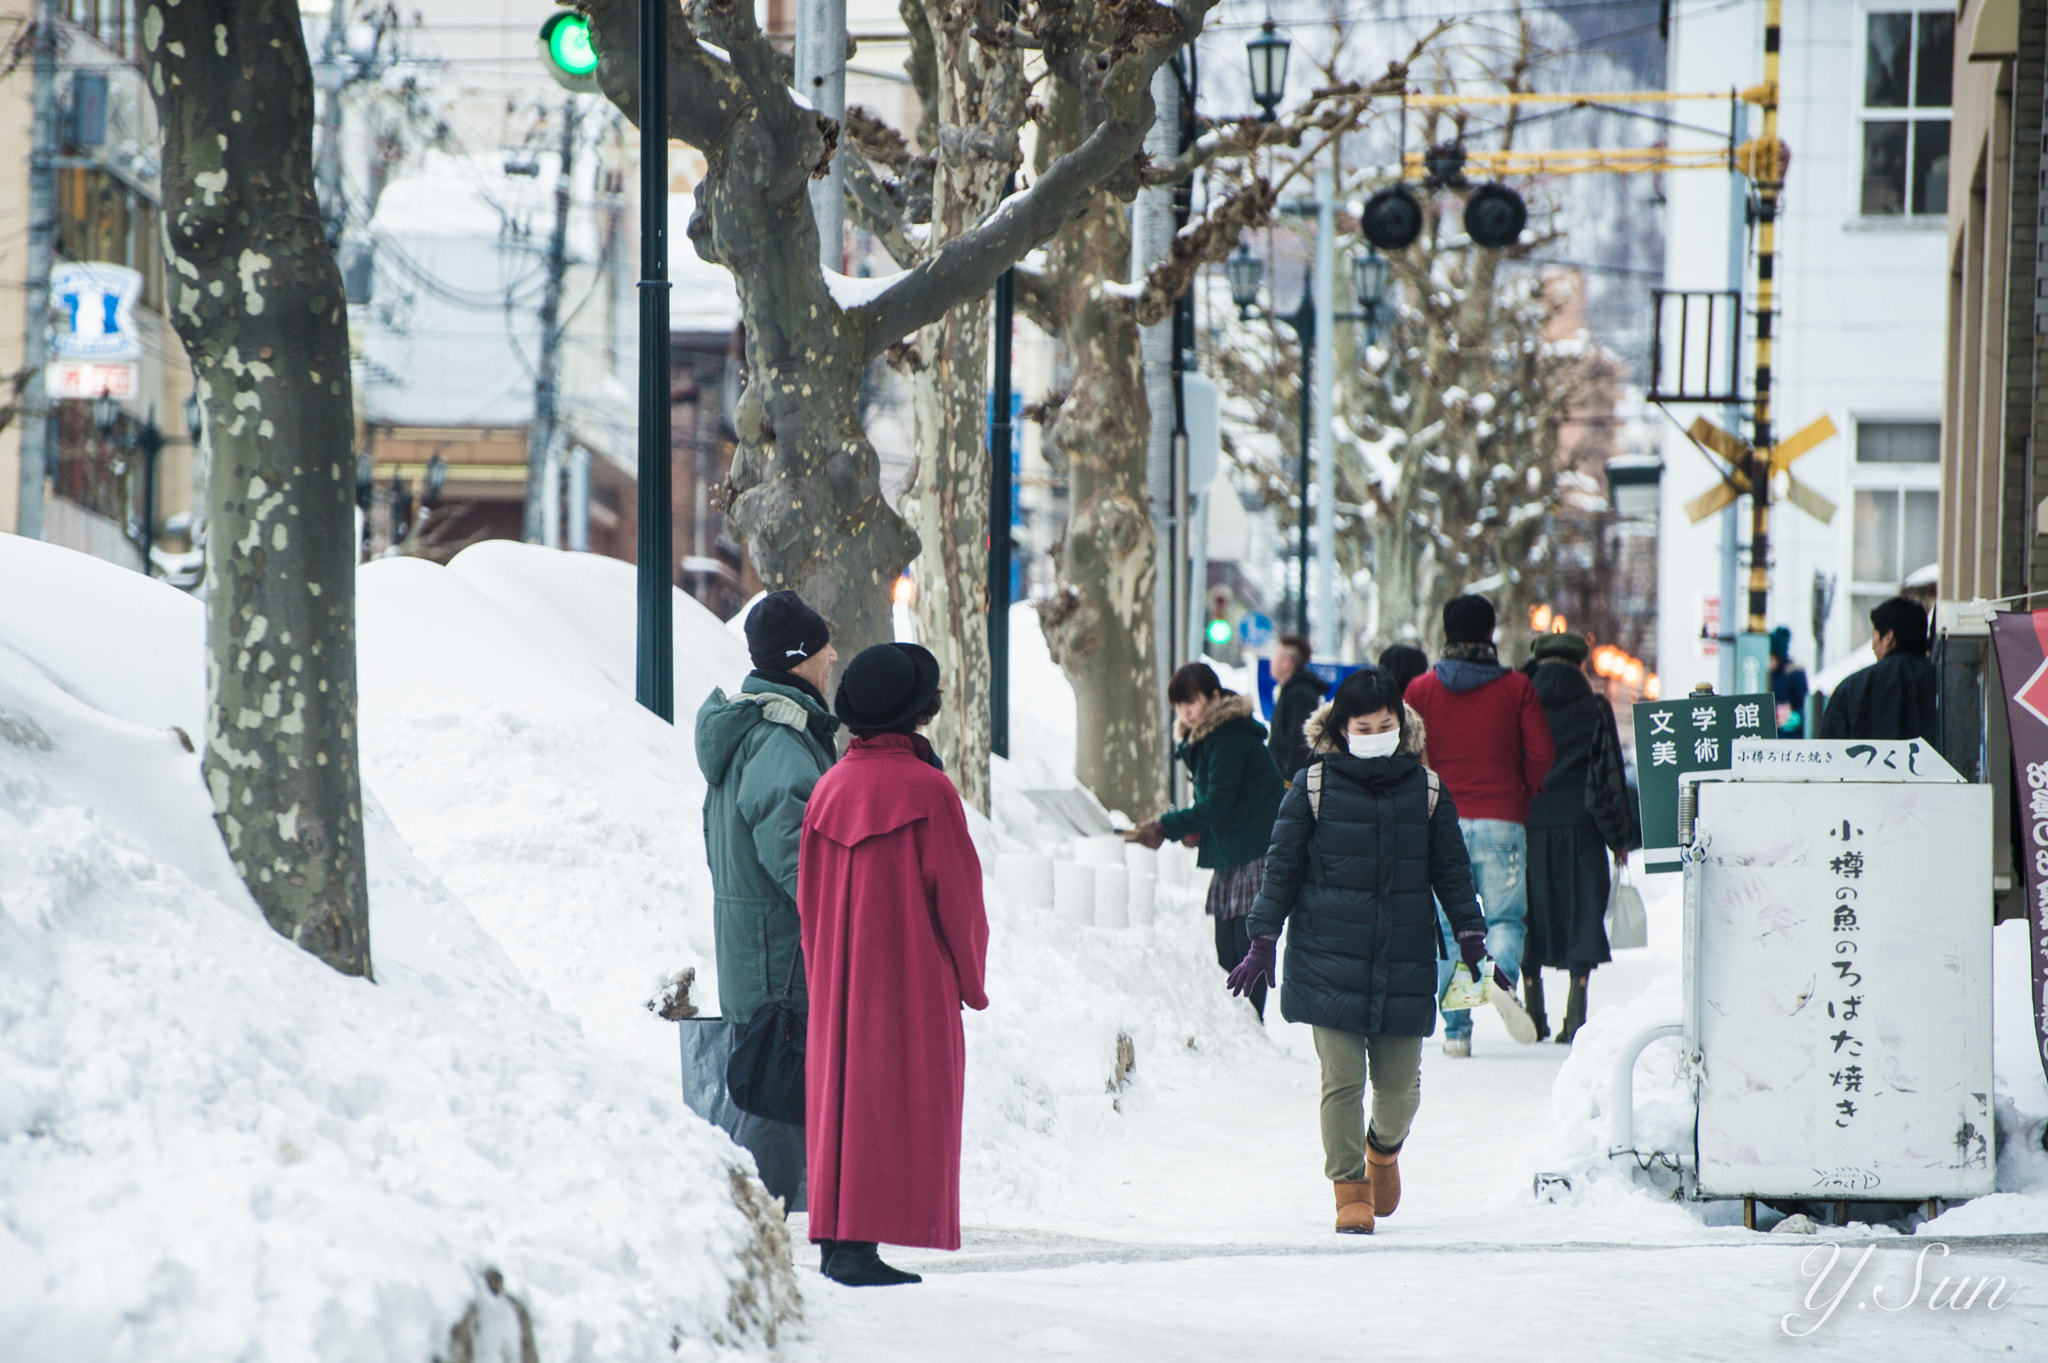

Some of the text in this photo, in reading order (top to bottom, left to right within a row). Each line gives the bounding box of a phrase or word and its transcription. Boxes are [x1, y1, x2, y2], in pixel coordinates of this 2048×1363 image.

[1649, 702, 1760, 736] 文学館
[1651, 733, 1762, 767] 美術
[1737, 742, 1926, 776] 小樽ろばた焼き つくし
[1827, 819, 1864, 1129] 小樽の魚のろばた焼き
